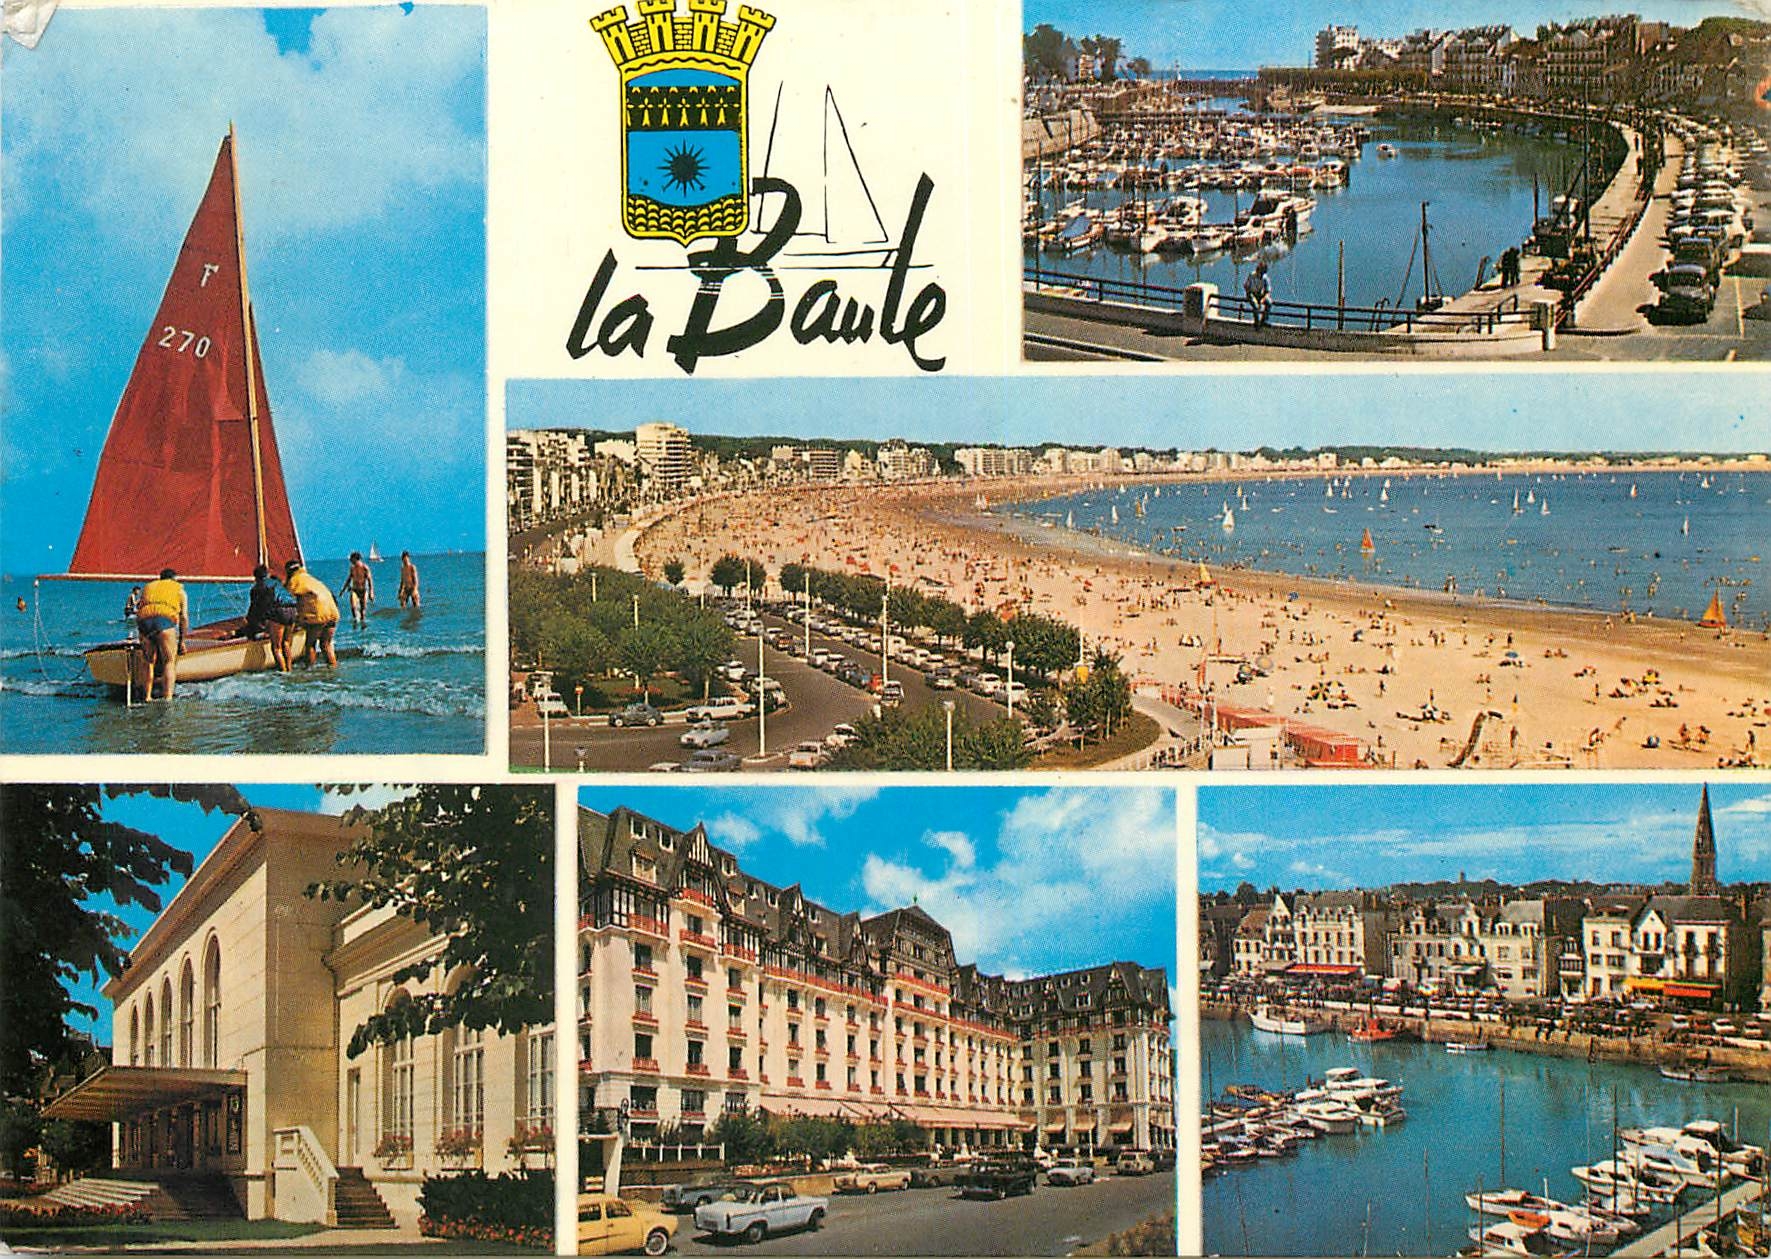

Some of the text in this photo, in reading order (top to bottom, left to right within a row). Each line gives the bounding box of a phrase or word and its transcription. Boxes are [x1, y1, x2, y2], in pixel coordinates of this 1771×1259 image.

[566, 171, 946, 376] la Baule
[158, 325, 211, 358] 270
